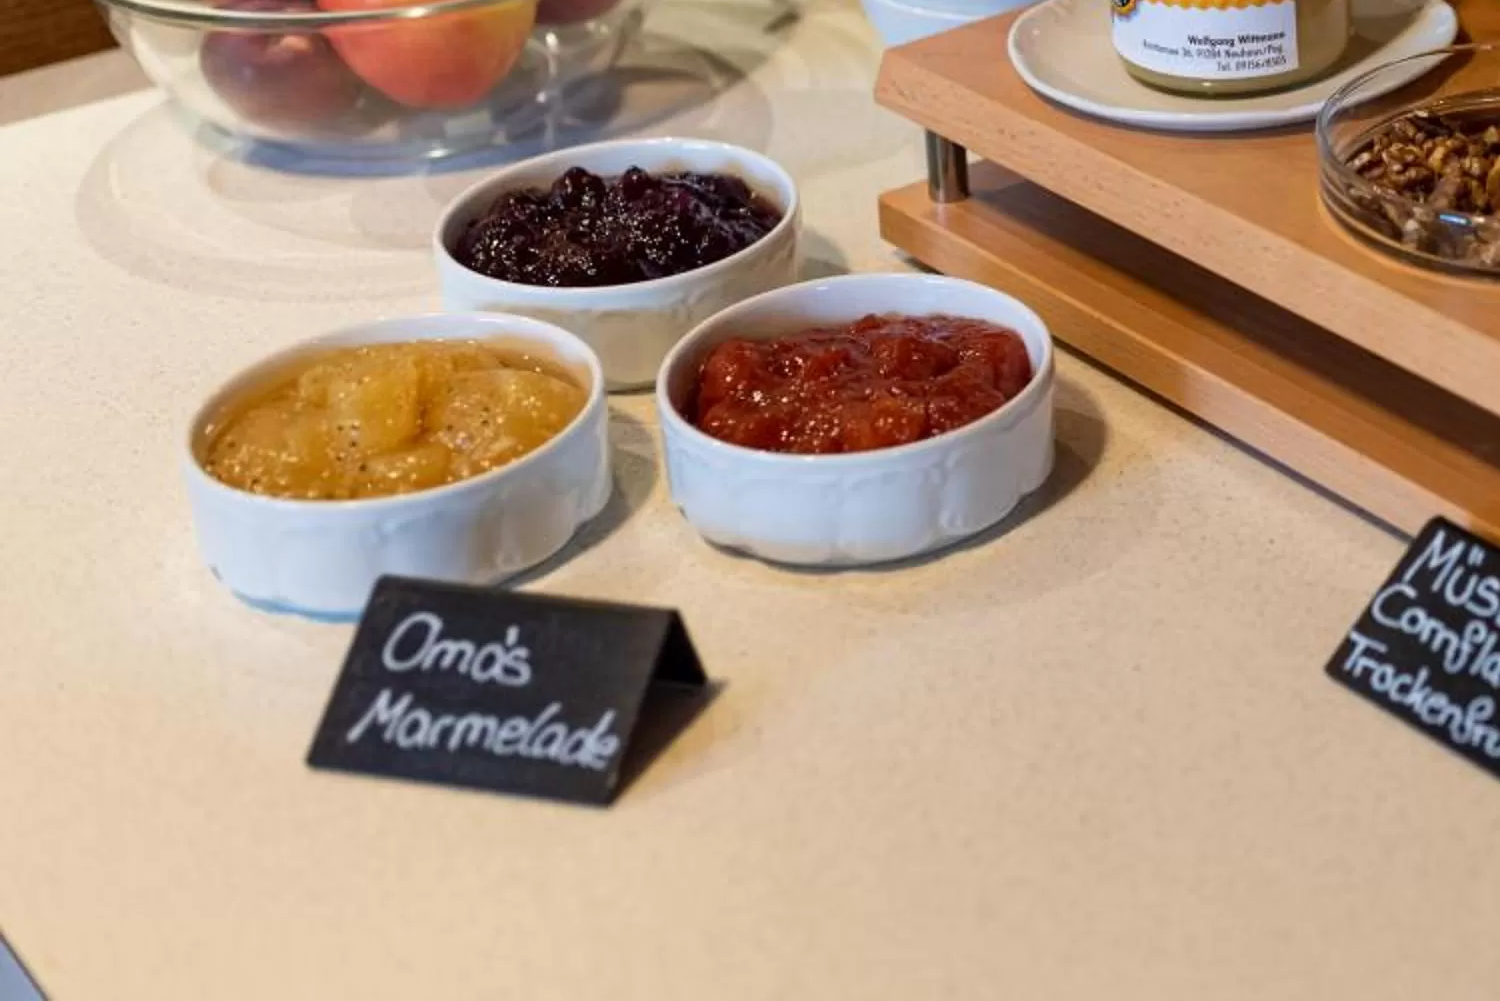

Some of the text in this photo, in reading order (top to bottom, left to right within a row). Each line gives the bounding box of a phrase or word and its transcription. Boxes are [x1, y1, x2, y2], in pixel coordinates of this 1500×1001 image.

[1187, 34, 1235, 48] Wolfgang
[382, 611, 532, 687] Oma's
[346, 689, 621, 770] Marmelade
